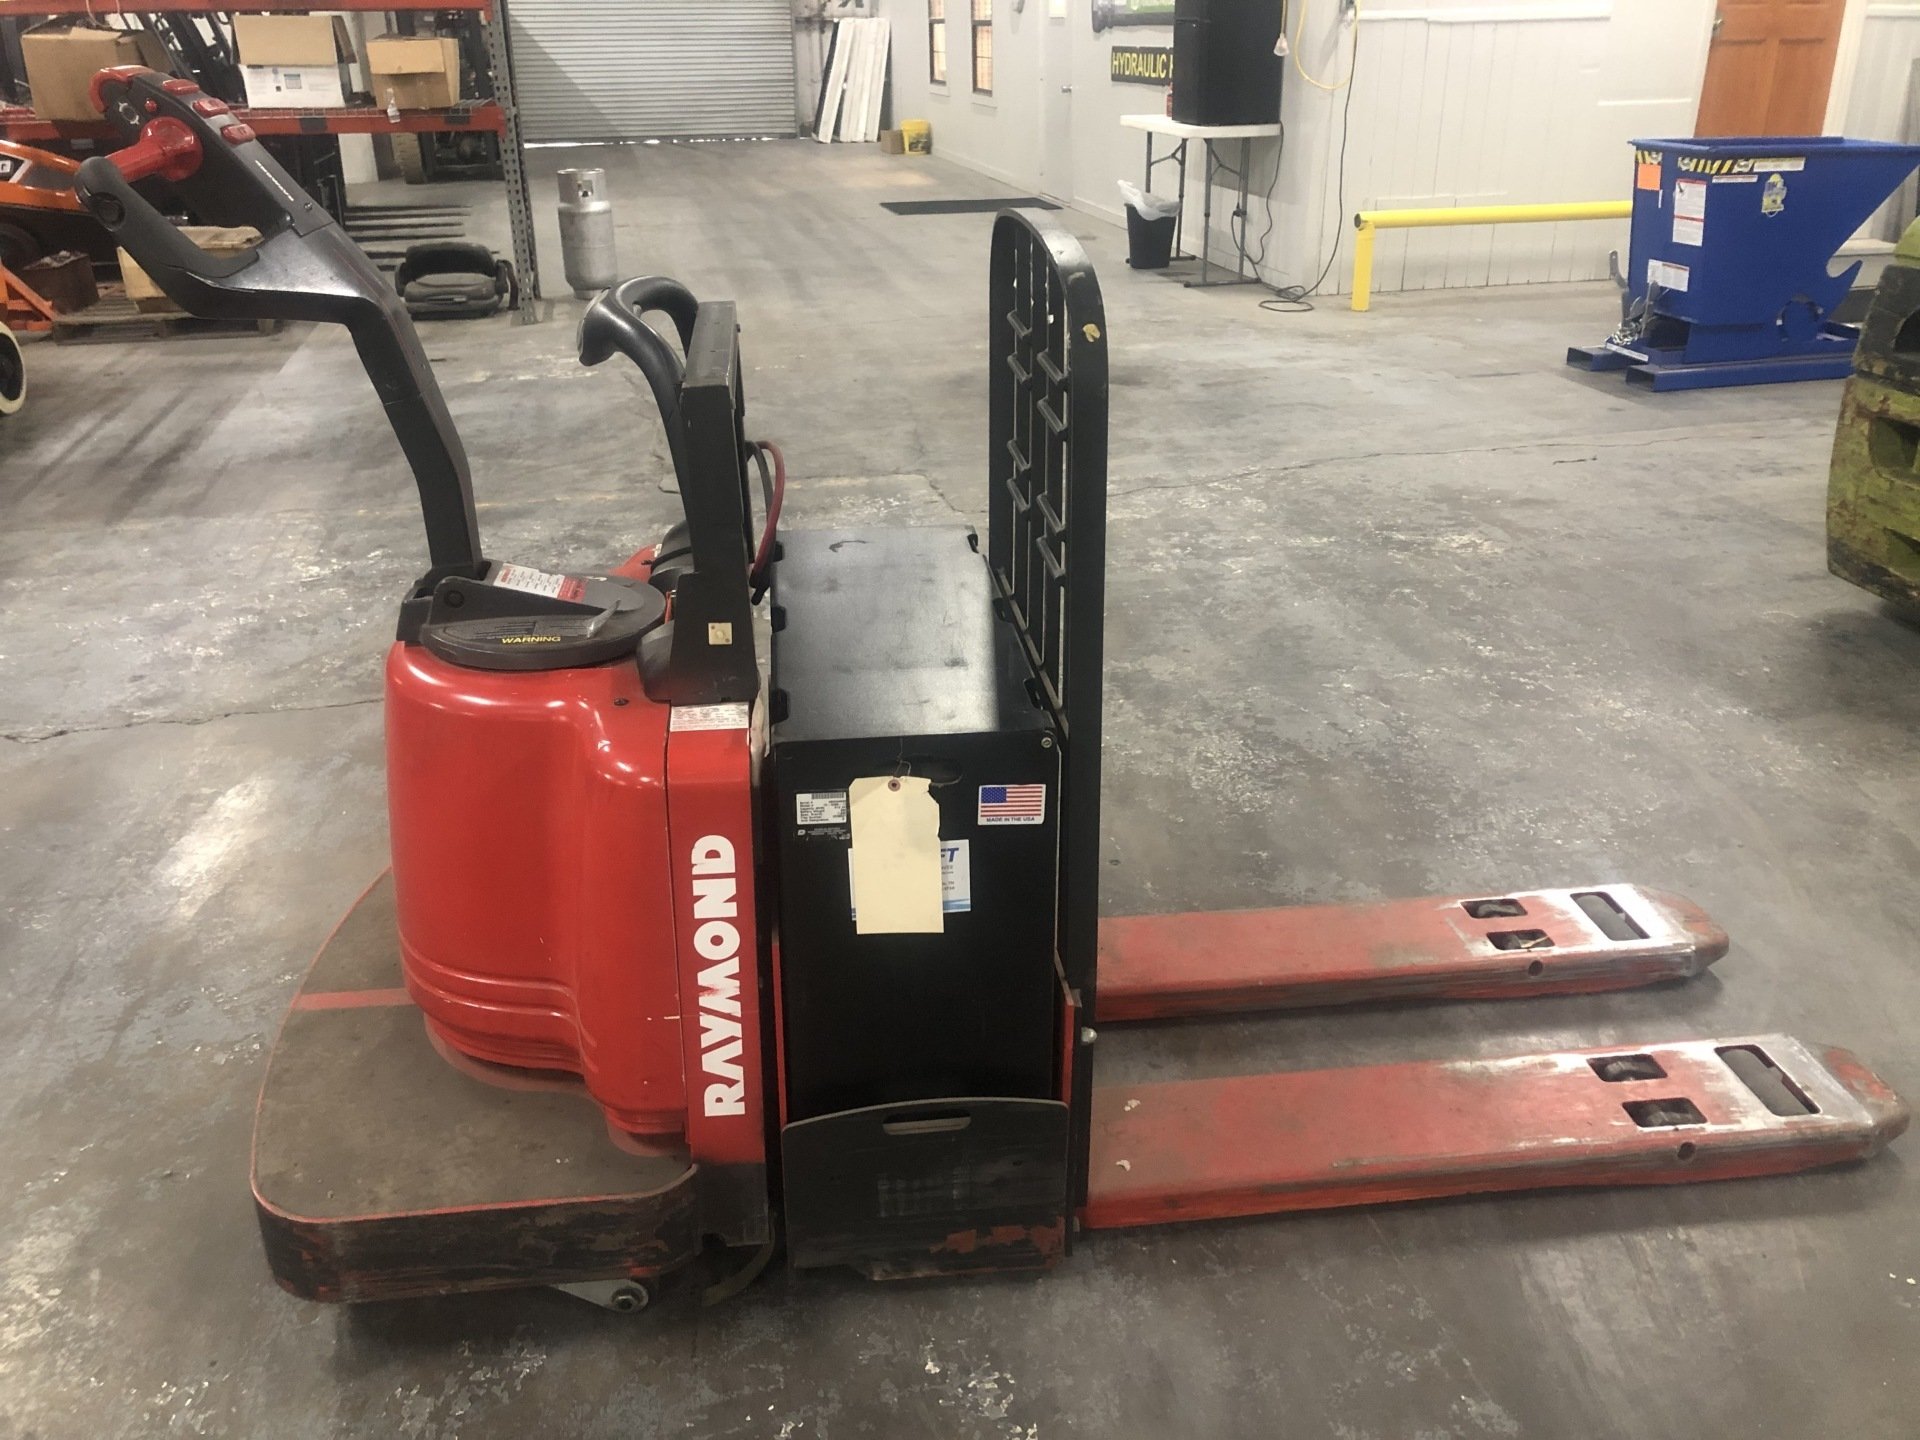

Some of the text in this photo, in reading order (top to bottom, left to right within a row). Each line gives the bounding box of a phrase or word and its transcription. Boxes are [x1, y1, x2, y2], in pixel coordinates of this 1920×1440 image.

[1112, 52, 1167, 79] HYDRAULIC
[502, 635, 561, 644] WARNING
[691, 834, 746, 1117] RAYMOND
